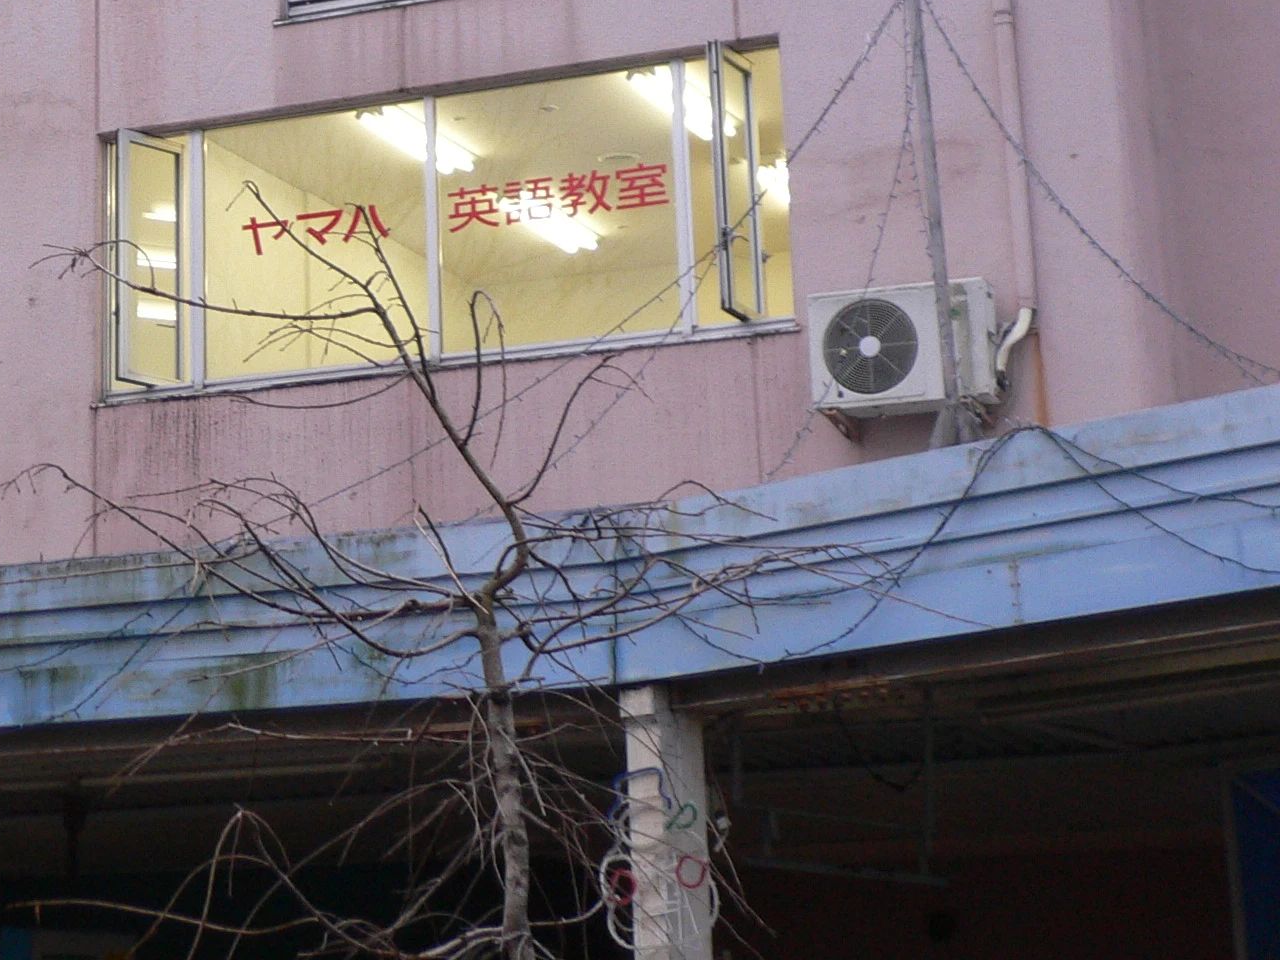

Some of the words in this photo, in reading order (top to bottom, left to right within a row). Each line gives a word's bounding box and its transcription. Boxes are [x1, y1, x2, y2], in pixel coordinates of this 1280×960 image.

[242, 204, 390, 256] ヤマハ
[447, 162, 670, 233] 英語教室
